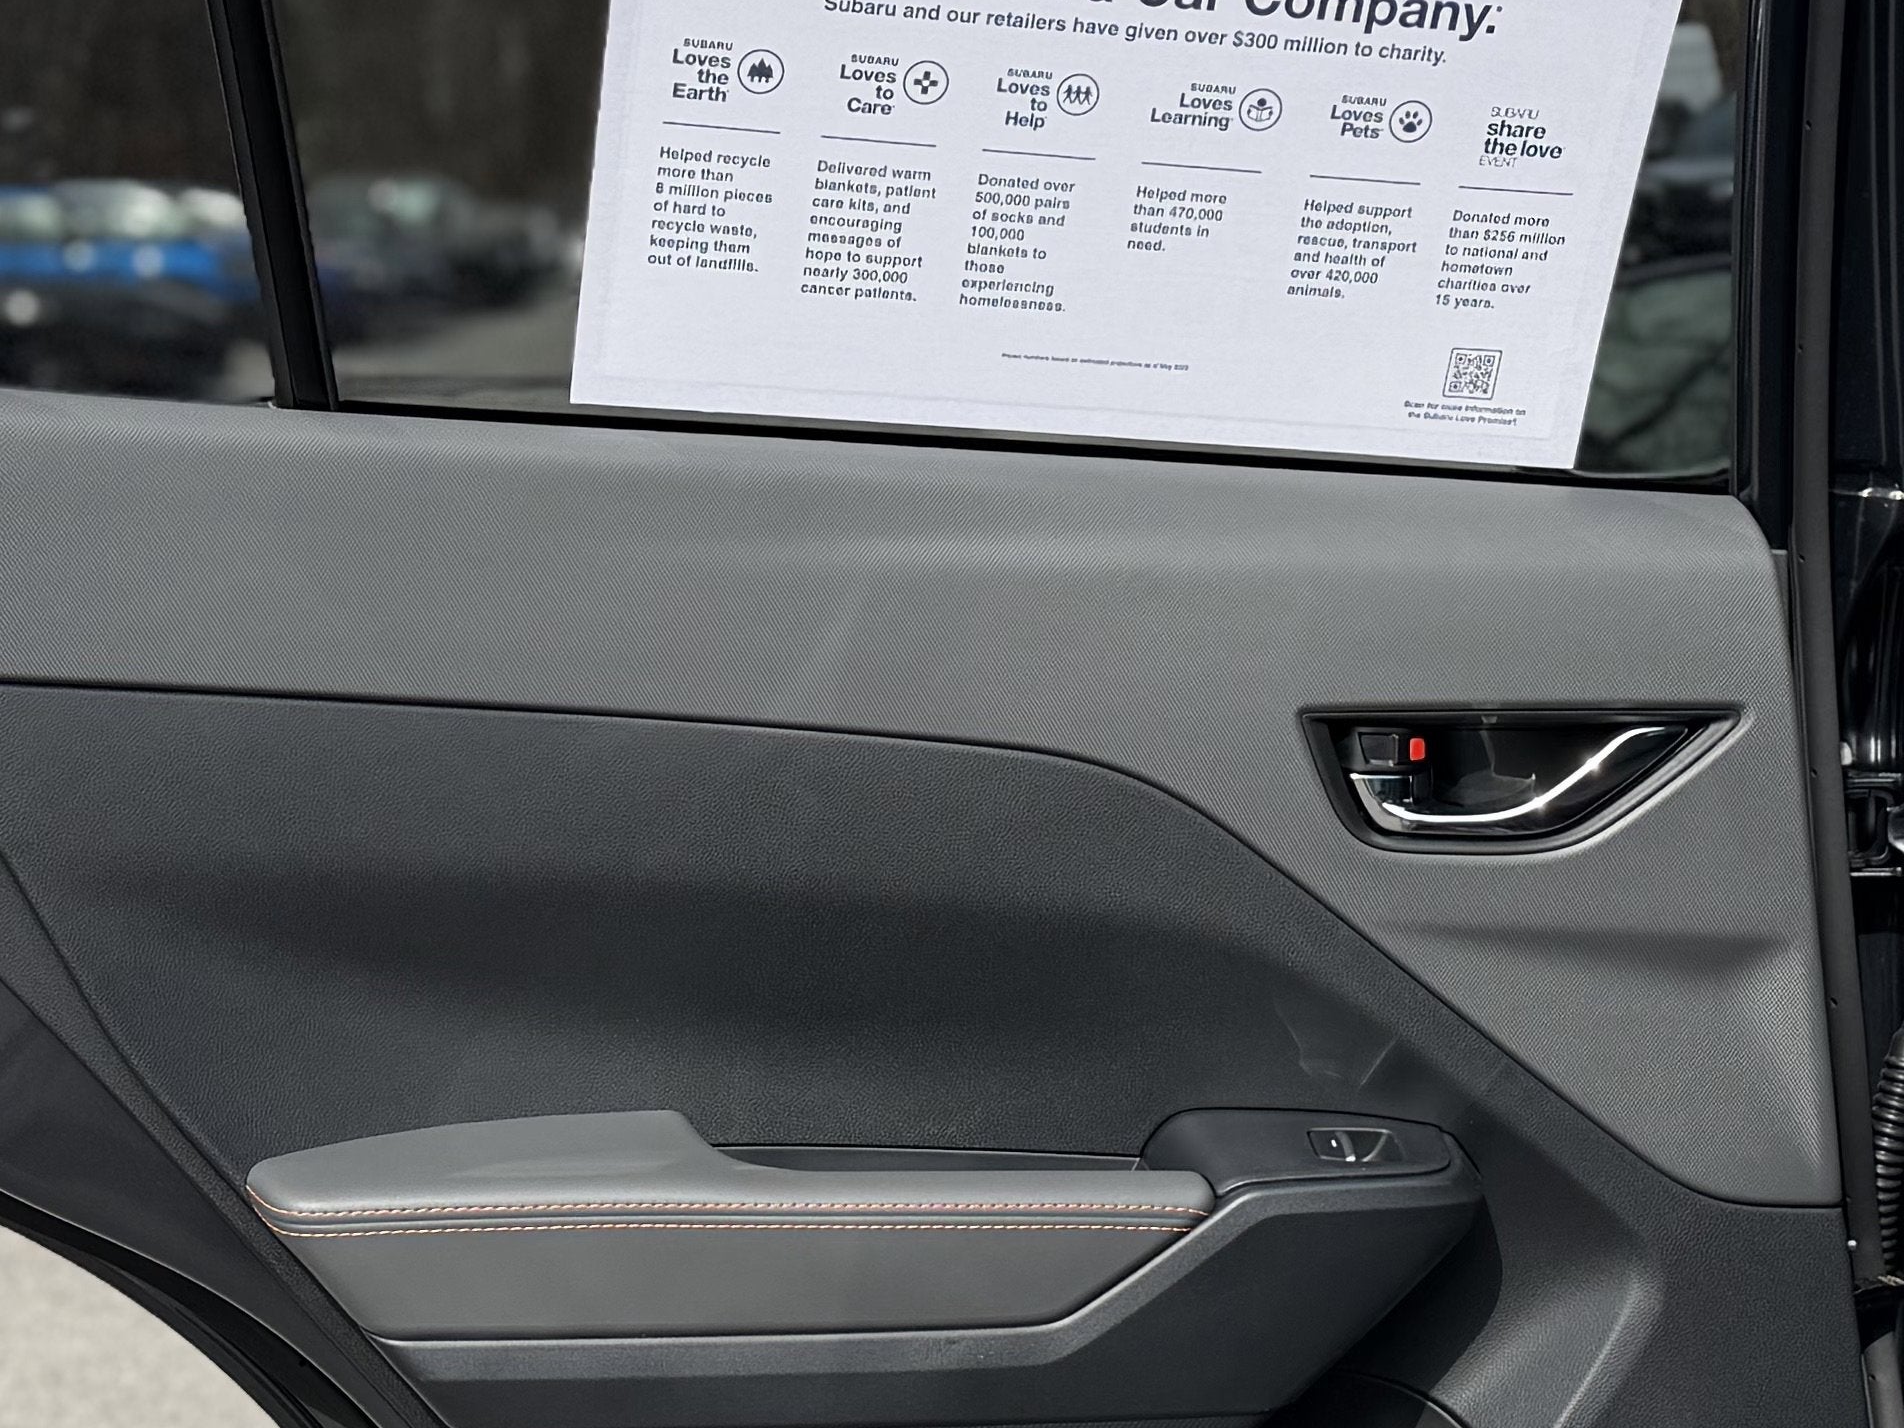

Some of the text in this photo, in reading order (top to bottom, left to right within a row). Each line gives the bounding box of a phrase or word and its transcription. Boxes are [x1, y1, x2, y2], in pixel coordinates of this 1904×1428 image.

[903, 4, 941, 21] and
[946, 10, 981, 24] our
[986, 12, 1066, 32] retailers
[1072, 17, 1119, 36] have
[1124, 22, 1178, 42] given
[1184, 30, 1228, 46] over
[1232, 30, 1278, 50] $300
[1283, 36, 1348, 56] million
[1354, 41, 1373, 57] to
[1378, 43, 1446, 67] charity.
[672, 48, 731, 69] Loves
[697, 68, 729, 85] the
[840, 63, 897, 84] Loves
[672, 82, 729, 103] Earth
[875, 85, 894, 100] to
[996, 77, 1050, 97] Loves
[847, 97, 895, 115] Care
[1030, 97, 1048, 112] to
[1179, 92, 1233, 111] Loves
[1005, 110, 1047, 131] Help
[1150, 107, 1234, 131] Learning
[1330, 104, 1383, 123] Loves
[1340, 121, 1384, 139] Pets
[1486, 119, 1546, 140] share
[1484, 137, 1566, 159] the love
[660, 146, 771, 169] Helped recycle
[657, 166, 733, 182] more than
[817, 160, 931, 181] Delivered warm
[814, 177, 936, 199] blankets, patient
[978, 173, 1076, 192] Donated over
[655, 182, 772, 203] 8 million pieces
[975, 191, 1070, 210] 500,000 pairs
[1136, 185, 1227, 205] Helped more
[653, 199, 726, 217] of hard to
[812, 198, 911, 215] care kits, and
[1133, 204, 1223, 221] than 470,000
[1304, 198, 1412, 220] Helped support
[810, 215, 902, 234] encouraging
[972, 208, 1065, 227] of socks and
[1301, 216, 1392, 236] the adoption,
[1452, 209, 1550, 227] Donated more
[651, 219, 757, 240] recycle waste,
[972, 225, 1025, 241] 100,000
[1130, 221, 1209, 238] students in
[1449, 227, 1565, 245] than $256 million
[650, 234, 750, 254] keeping them
[887, 236, 902, 248] of
[967, 242, 1047, 260] blankets to
[1127, 239, 1166, 252] need.
[1297, 235, 1417, 254] rescue, transport
[647, 254, 672, 266] out
[676, 254, 692, 267] of
[805, 246, 923, 268] hope to support
[1293, 250, 1386, 268] and health of
[1445, 244, 1548, 261] to national and
[803, 266, 908, 284] nearly 300,000
[964, 259, 1005, 274] those
[1290, 268, 1378, 284] over 420,000
[800, 284, 851, 296] cancer
[1287, 284, 1345, 299] animals.
[1501, 284, 1531, 294] over
[1436, 294, 1494, 310] 15 years.
